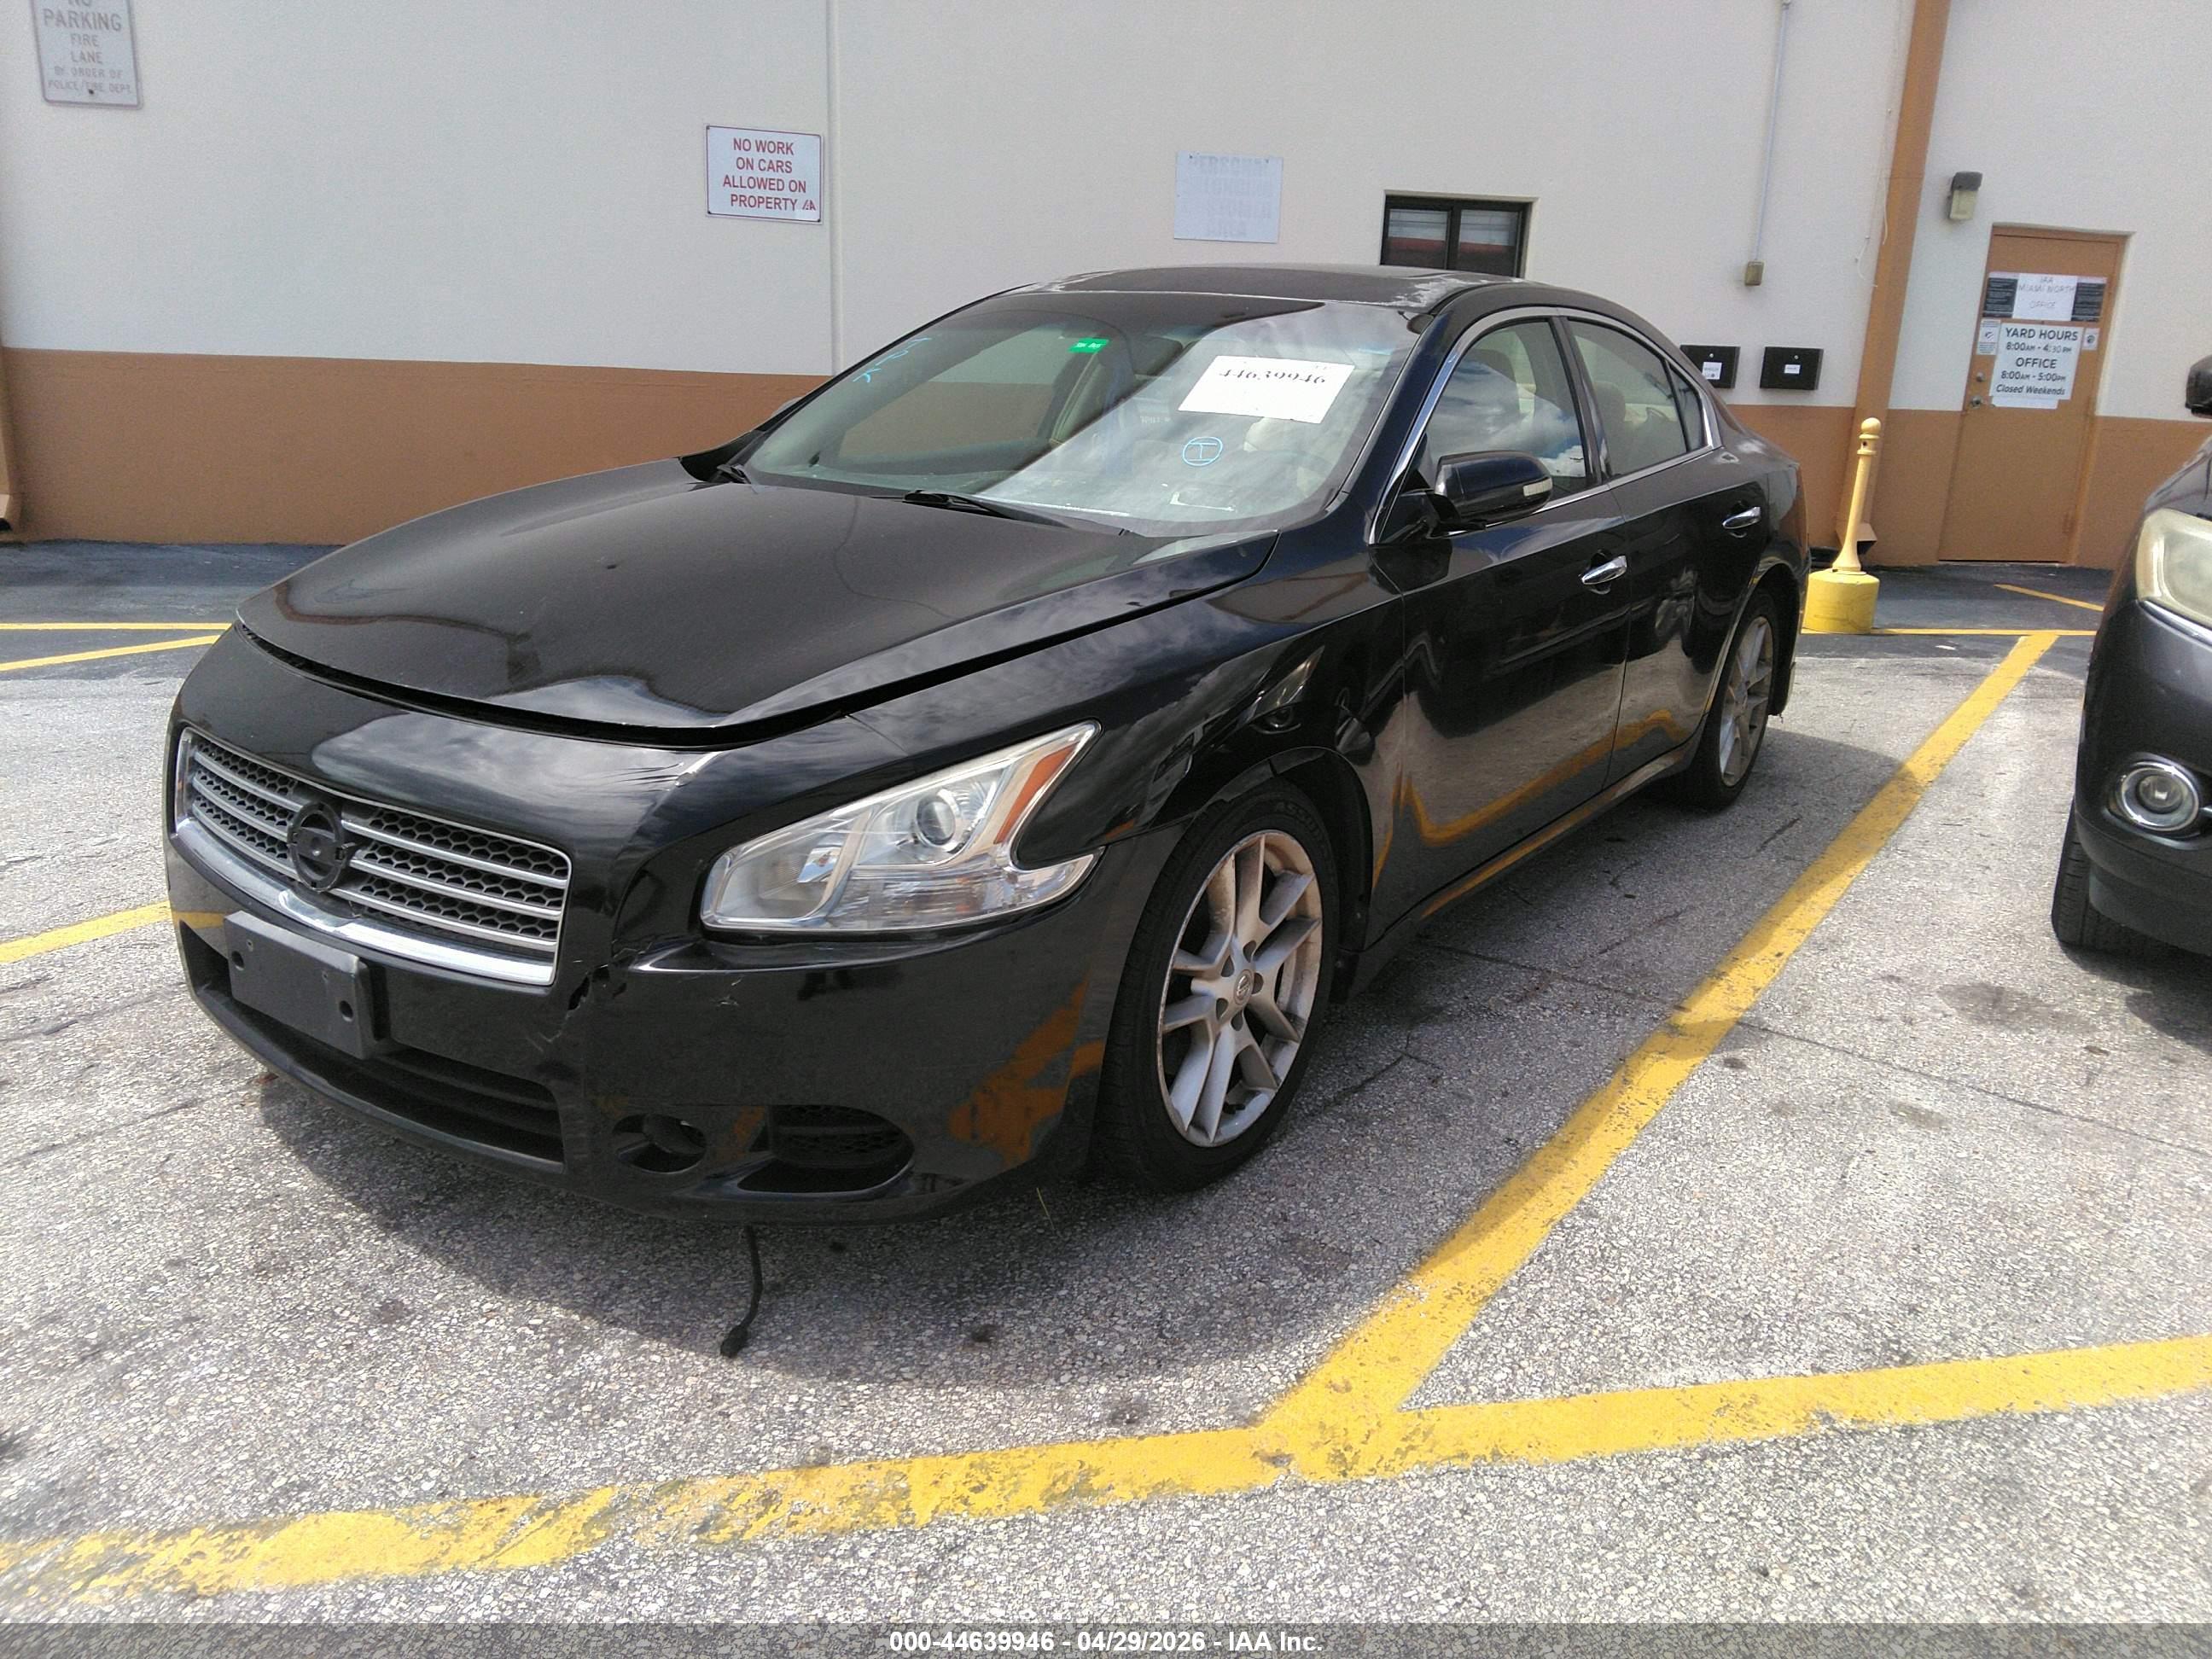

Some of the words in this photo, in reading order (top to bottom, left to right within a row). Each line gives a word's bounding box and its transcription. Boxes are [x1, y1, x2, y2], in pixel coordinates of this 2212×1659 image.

[43, 8, 122, 32] PARKING
[70, 32, 100, 47] FIRE
[70, 50, 104, 65] LANE
[733, 137, 752, 152] NO
[754, 139, 795, 155] WORK
[736, 156, 754, 171] ON
[758, 158, 793, 174] CARS
[723, 174, 785, 192] ALLOWED
[789, 179, 806, 193] ON
[731, 194, 798, 212] PROPERTY
[2005, 327, 2036, 339] YARD
[2038, 329, 2079, 341] HOURS
[2006, 341, 2035, 352] 8:00AM
[2043, 344, 2062, 353] 4:30
[2015, 357, 2058, 369] OFFICE
[2000, 370, 2031, 381] 8:00AM
[2037, 372, 2067, 382] 5:00PM
[1996, 384, 2023, 393] Closed
[2025, 385, 2065, 395] Weekends
